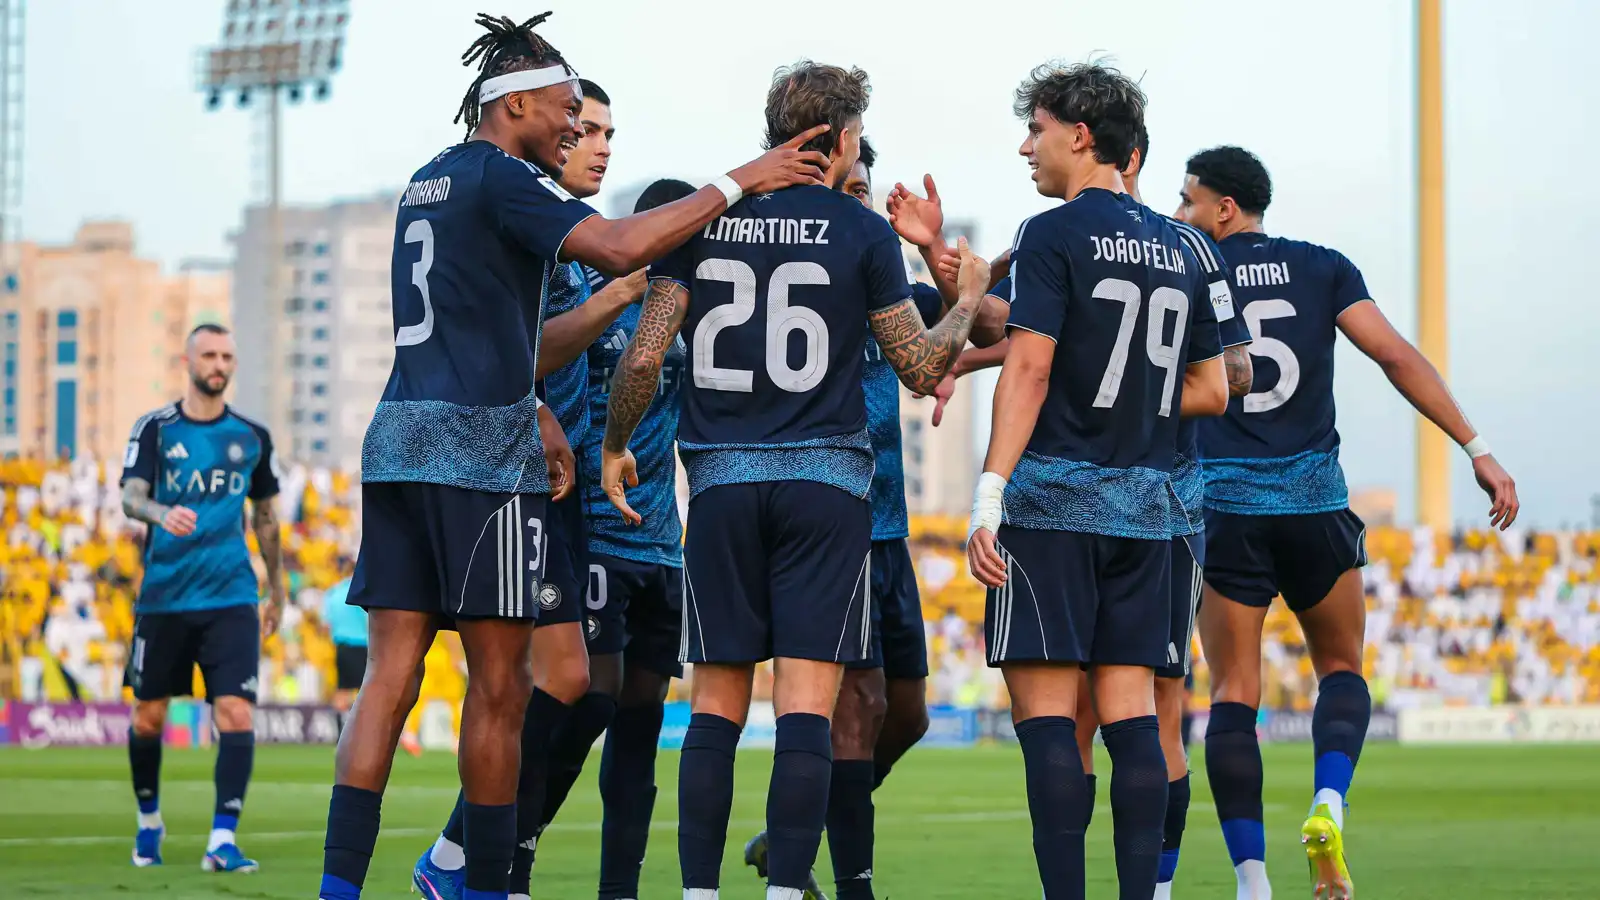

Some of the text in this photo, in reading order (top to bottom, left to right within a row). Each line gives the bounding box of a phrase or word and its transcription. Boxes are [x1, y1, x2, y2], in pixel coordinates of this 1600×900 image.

[395, 219, 433, 345] 3
[1090, 231, 1141, 264] JOÃO
[1236, 262, 1290, 287] AMRI
[693, 258, 830, 392] 26
[1091, 277, 1189, 417] 79
[1242, 299, 1300, 413] 5
[165, 468, 245, 496] KAFD
[527, 517, 543, 571] 3
